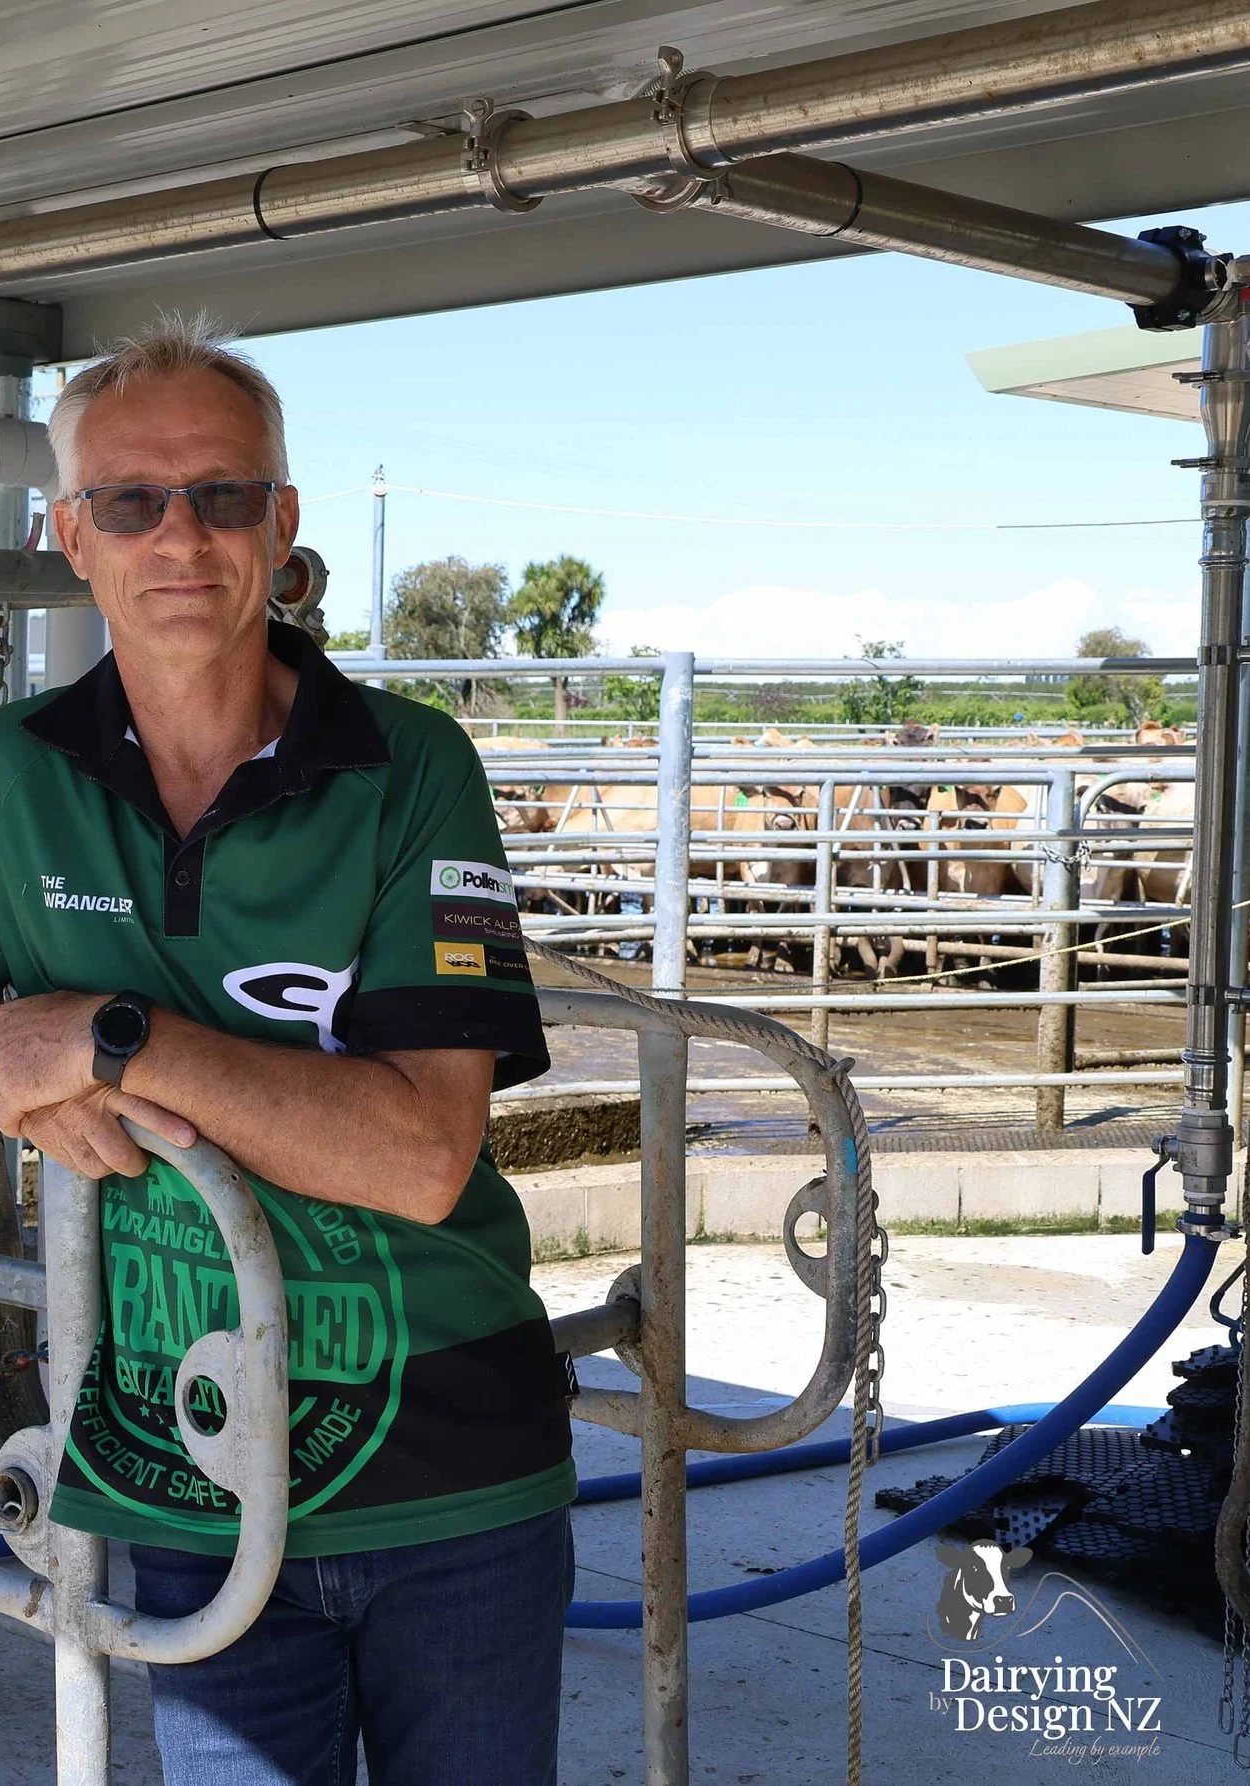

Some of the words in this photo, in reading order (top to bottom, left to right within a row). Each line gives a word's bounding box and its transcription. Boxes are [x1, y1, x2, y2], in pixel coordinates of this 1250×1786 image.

[41, 875, 66, 889] THE
[44, 892, 134, 914] WRANGLER
[444, 914, 491, 926] KIWICK
[444, 953, 475, 962] ROG
[293, 1398, 362, 1472] MADE
[77, 1388, 168, 1489] EFFICIENT
[168, 1470, 228, 1508] SAFE
